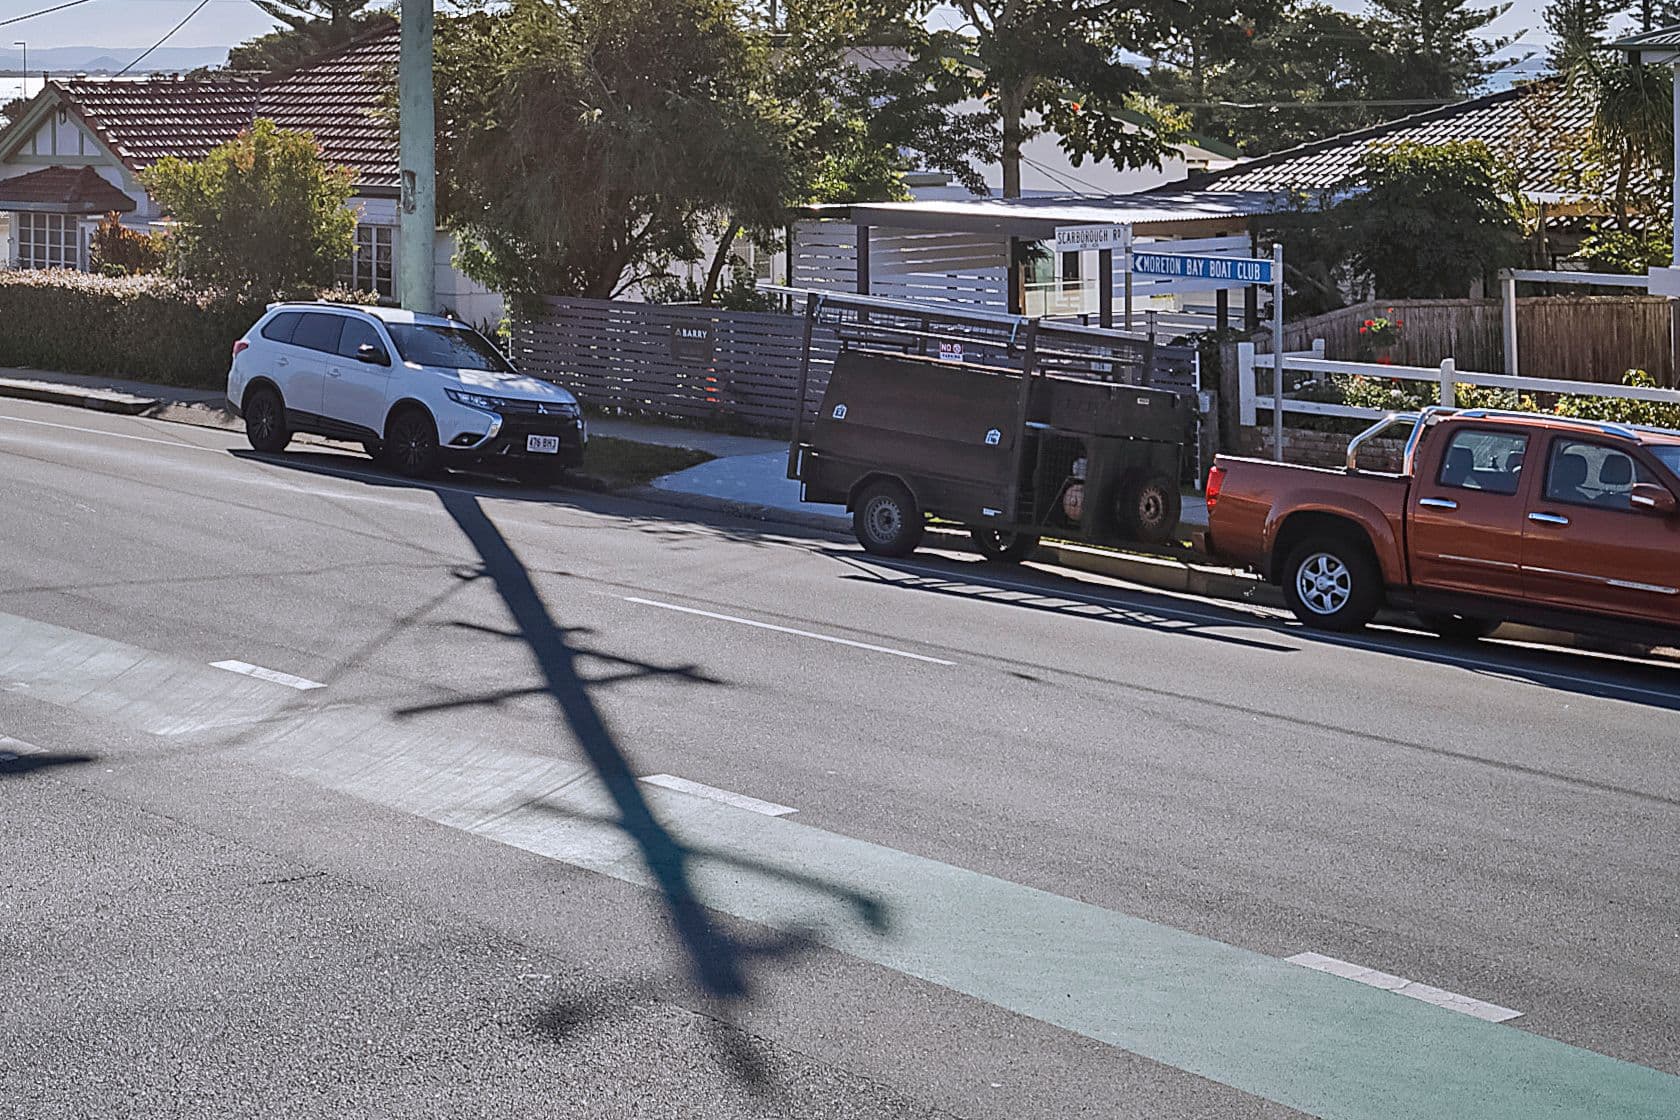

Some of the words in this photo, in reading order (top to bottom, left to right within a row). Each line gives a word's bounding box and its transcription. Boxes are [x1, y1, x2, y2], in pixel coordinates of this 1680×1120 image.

[1057, 230, 1108, 244] SCARBOROUGH
[1143, 256, 1180, 274] MORETON
[1186, 259, 1204, 276] BAY
[1209, 261, 1231, 278] BOAT
[1237, 262, 1260, 280] CLUB
